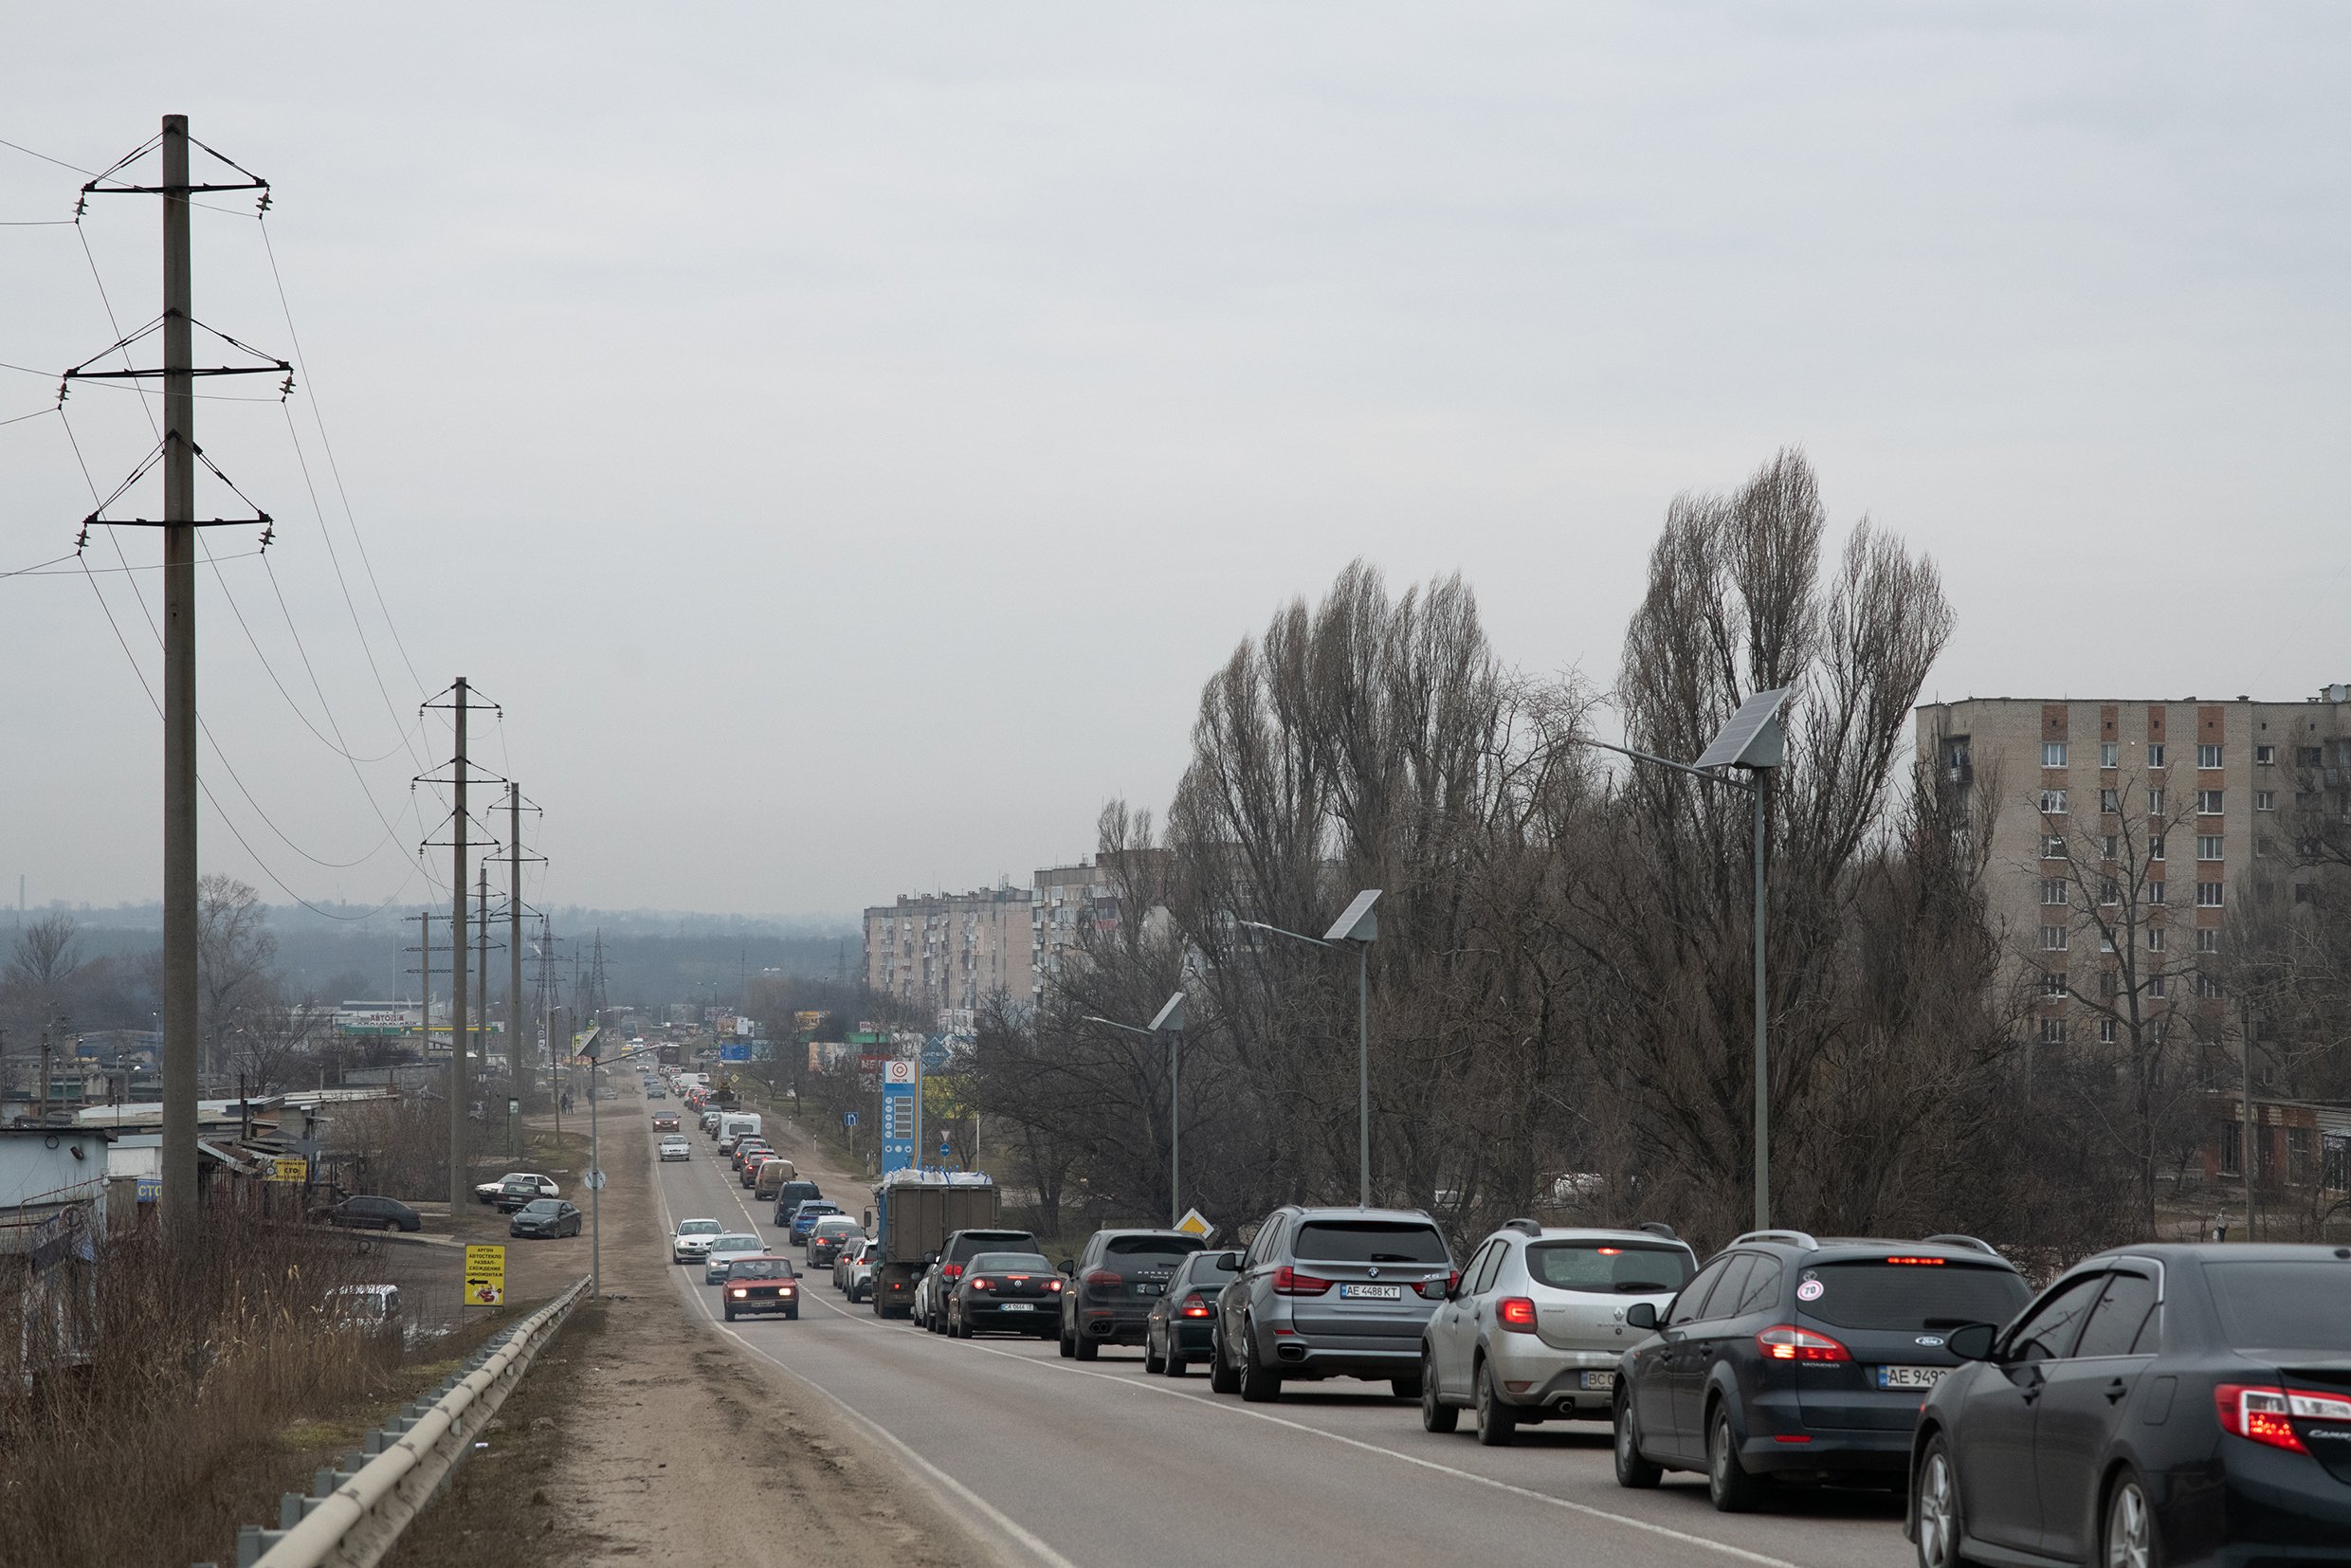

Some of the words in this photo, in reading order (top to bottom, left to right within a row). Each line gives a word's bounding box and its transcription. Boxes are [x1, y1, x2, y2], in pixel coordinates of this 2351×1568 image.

[1347, 1286, 1359, 1295] AE
[1362, 1287, 1382, 1296] 4488
[1384, 1287, 1397, 1297] KT
[1589, 1373, 1606, 1385] BC
[1888, 1369, 1910, 1384] AE
